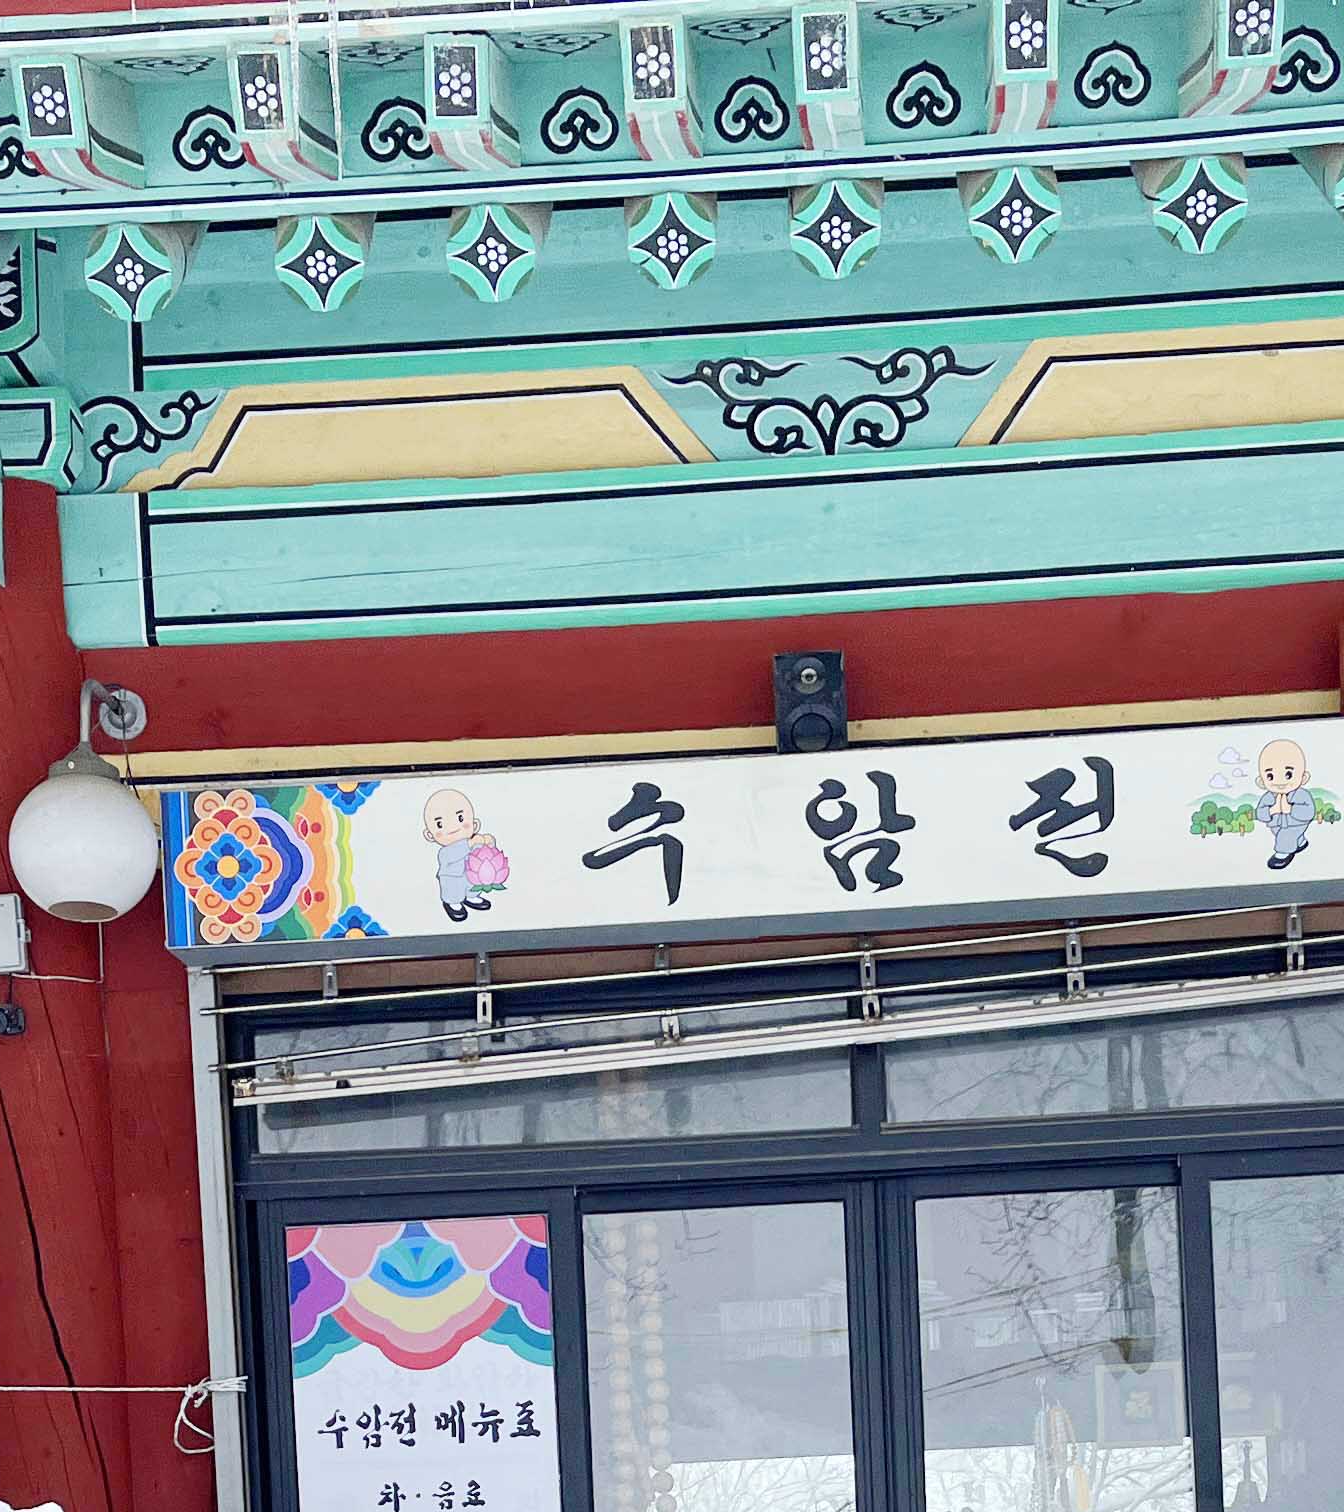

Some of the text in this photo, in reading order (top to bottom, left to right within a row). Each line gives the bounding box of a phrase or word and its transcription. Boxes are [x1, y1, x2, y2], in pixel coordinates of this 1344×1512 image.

[581, 755, 1116, 907] 수암전
[317, 1399, 541, 1449] 수암전 메뉴표
